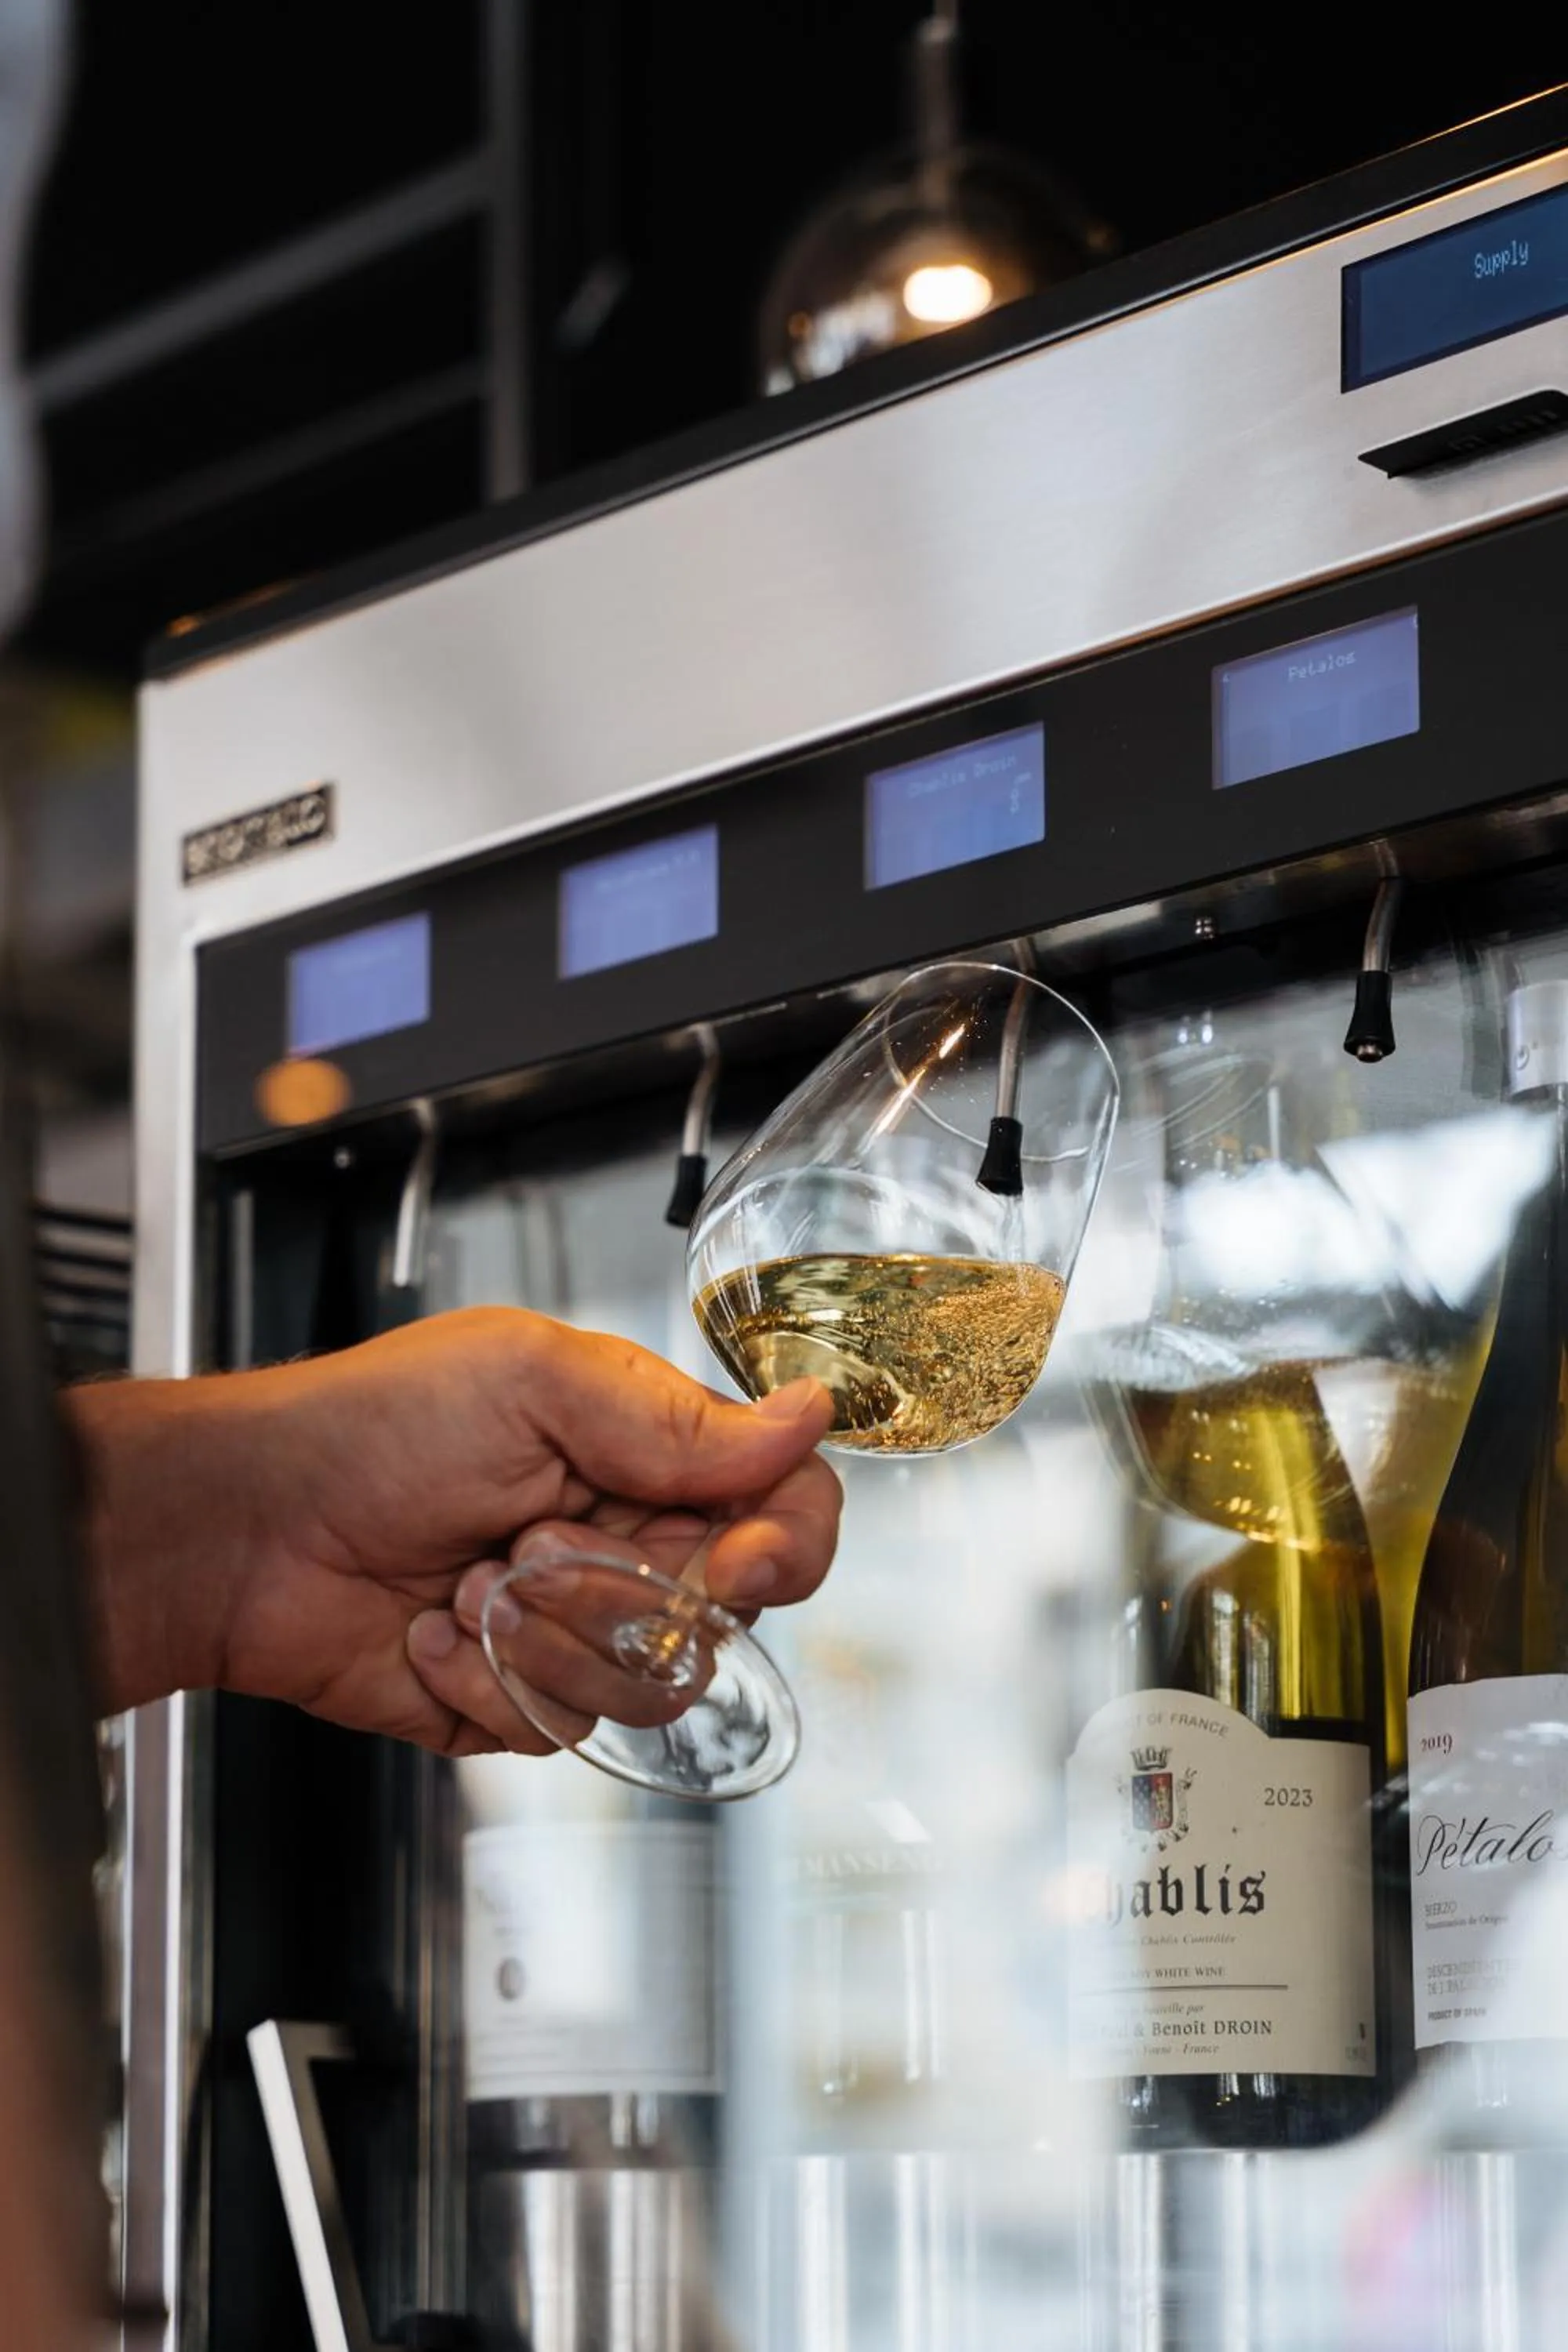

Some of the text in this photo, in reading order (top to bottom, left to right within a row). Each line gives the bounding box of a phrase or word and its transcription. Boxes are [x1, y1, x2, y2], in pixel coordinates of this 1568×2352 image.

[1474, 241, 1529, 278] Supply
[1287, 650, 1356, 683] Petalos
[1170, 1712, 1229, 1737] FRANCE
[1420, 1733, 1454, 1755] 2019
[1263, 1787, 1314, 1807] 2023
[1416, 1808, 1566, 1876] Pétalo
[1102, 1863, 1267, 1926] hablis
[1154, 1967, 1189, 1979] WHITE
[1195, 1965, 1225, 1977] WINE
[1152, 2019, 1207, 2037] Benoît
[1214, 2019, 1272, 2036] DROIN
